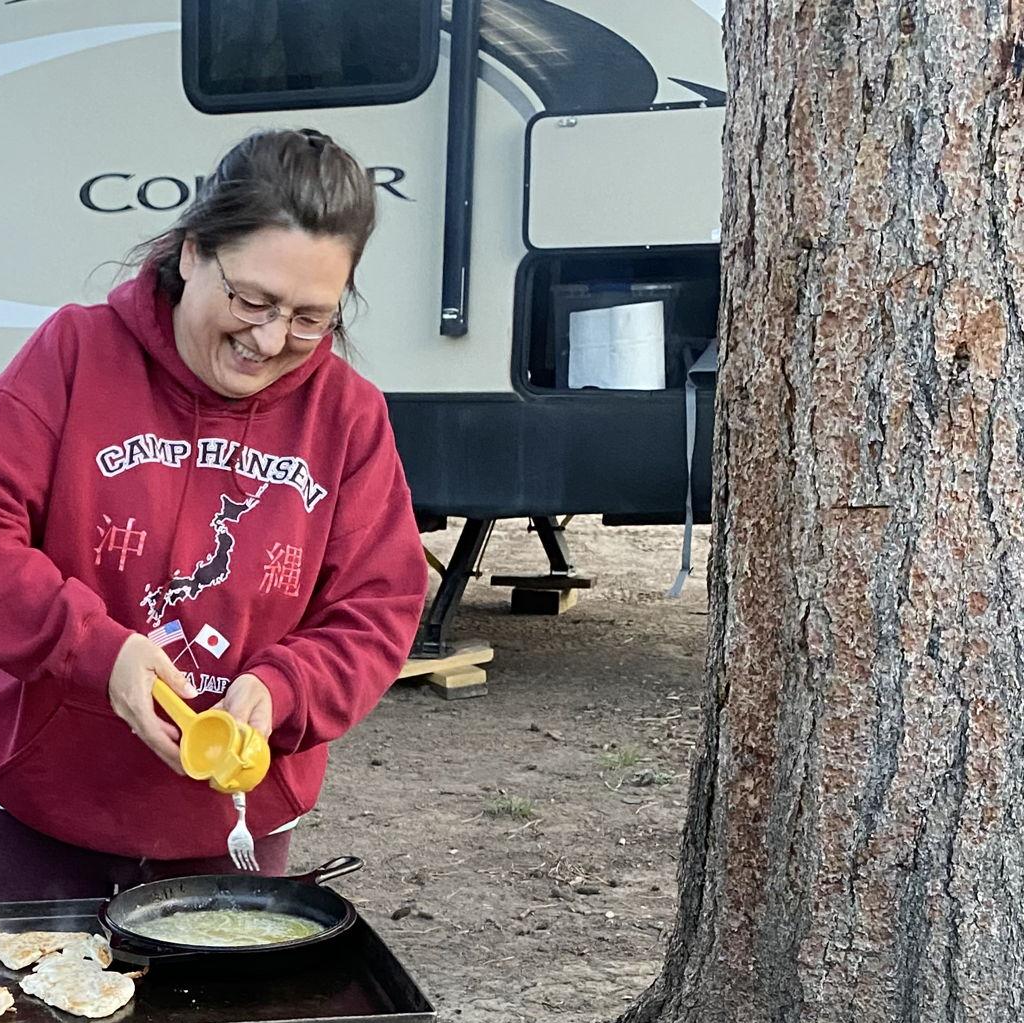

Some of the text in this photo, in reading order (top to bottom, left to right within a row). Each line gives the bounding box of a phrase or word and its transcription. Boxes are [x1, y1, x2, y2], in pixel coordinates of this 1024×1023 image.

[79, 165, 417, 214] COR
[96, 433, 327, 512] CAMP HANSEN
[94, 514, 147, 571] 沖
[197, 673, 231, 694] JAP
